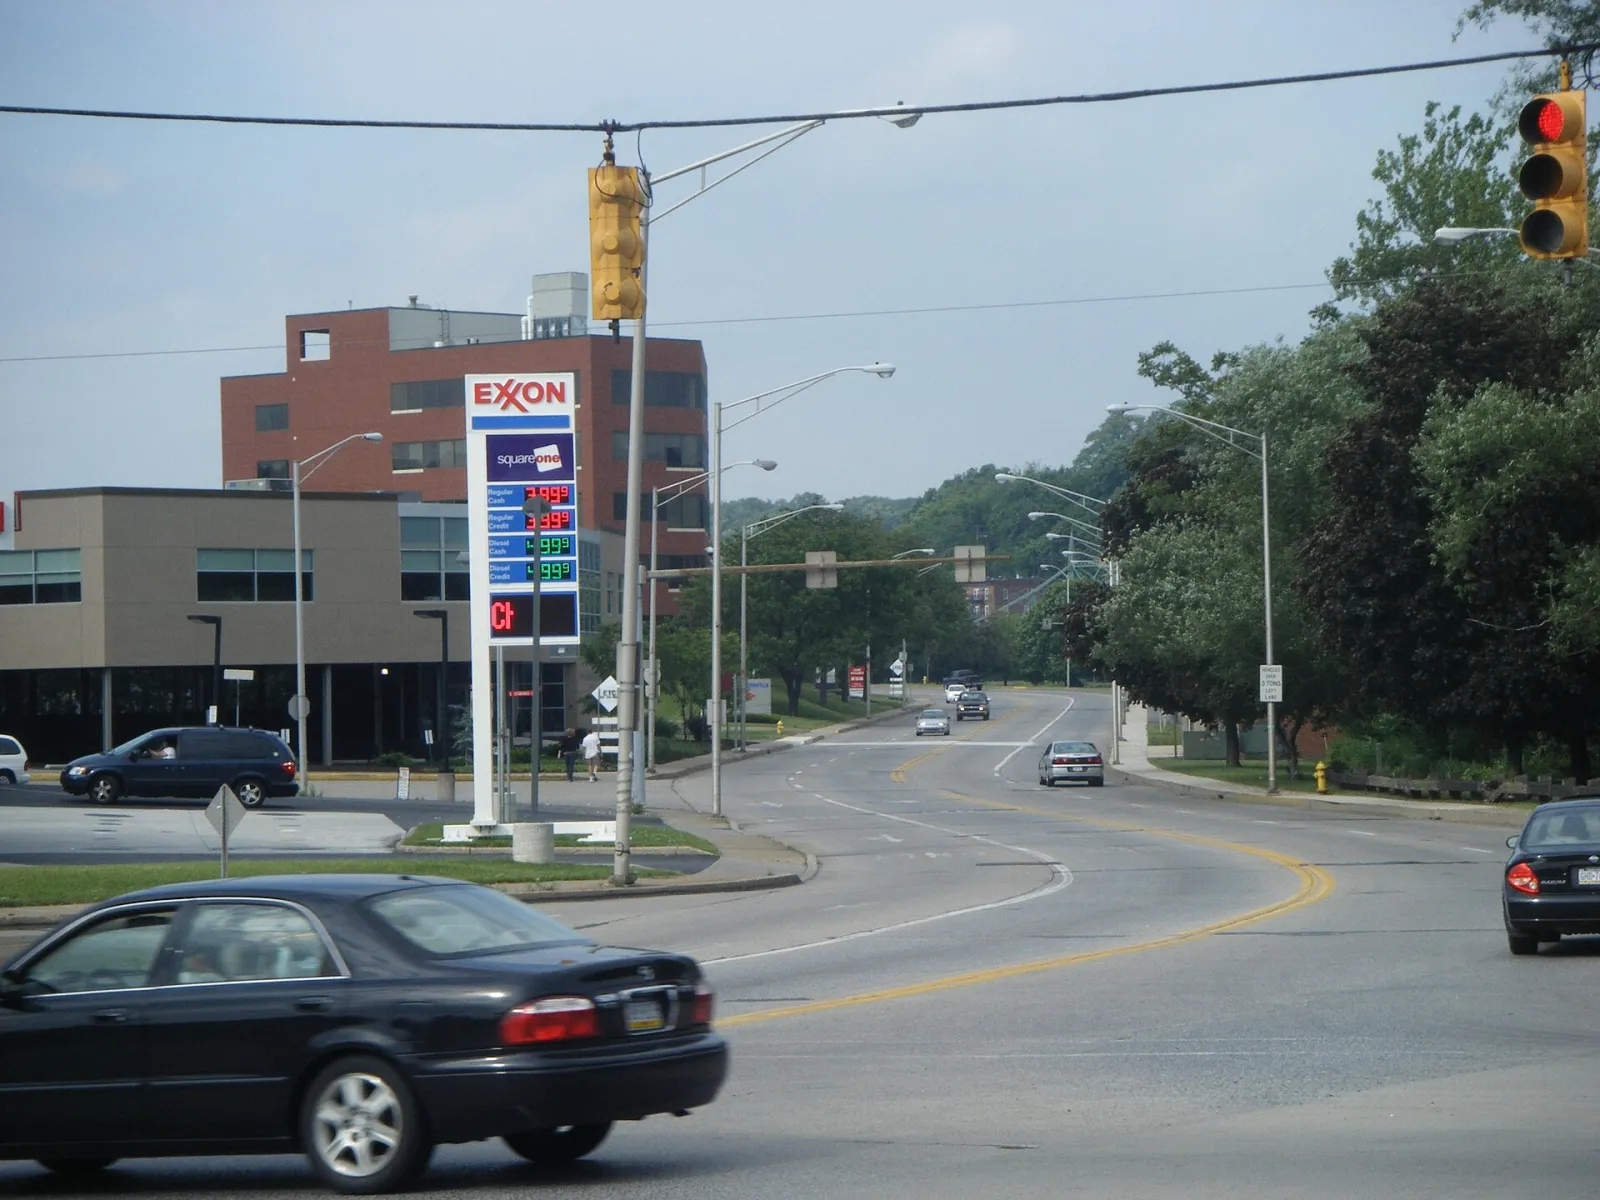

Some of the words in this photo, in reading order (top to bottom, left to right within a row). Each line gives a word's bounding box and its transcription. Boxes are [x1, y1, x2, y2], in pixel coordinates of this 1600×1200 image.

[474, 378, 566, 413] EXXON
[488, 487, 513, 496] Regular
[488, 513, 514, 522] Regular
